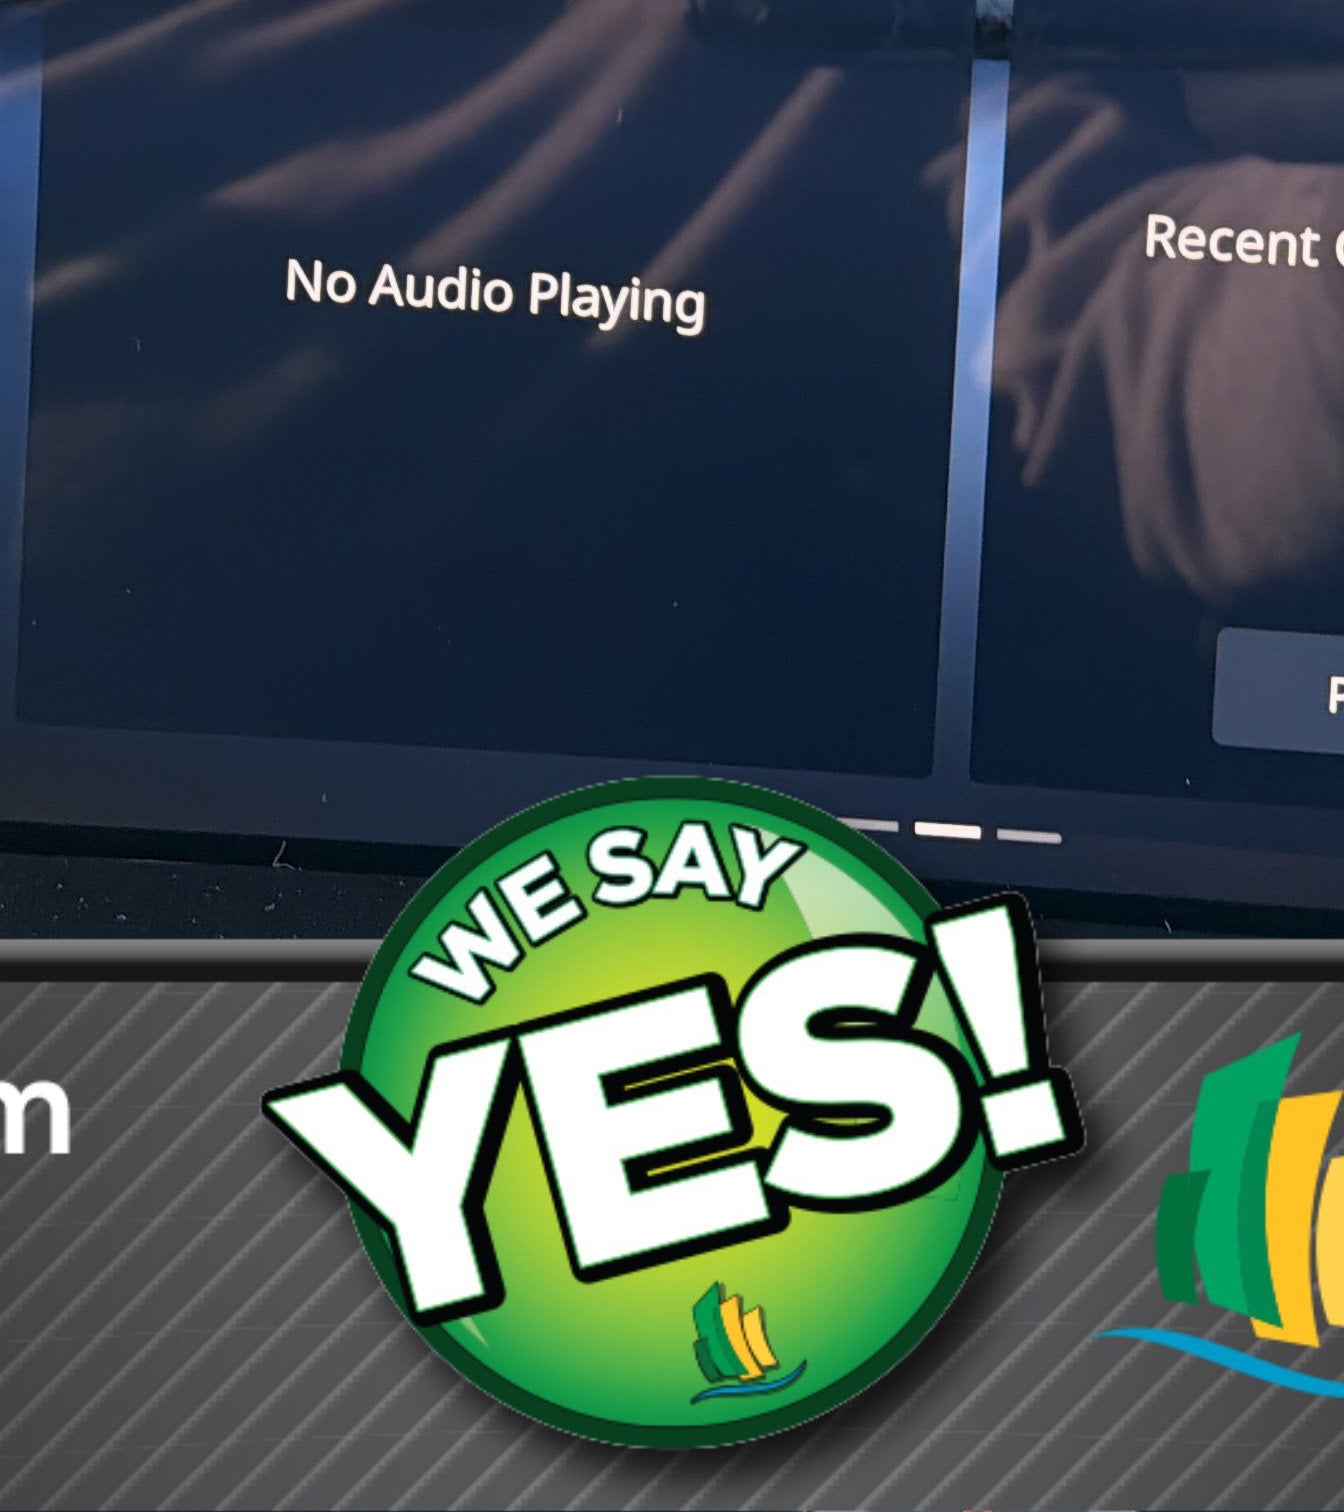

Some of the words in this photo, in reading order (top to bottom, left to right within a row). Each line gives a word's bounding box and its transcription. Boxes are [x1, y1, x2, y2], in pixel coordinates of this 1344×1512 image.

[1145, 213, 1321, 268] Recent
[286, 258, 357, 304] No
[367, 263, 514, 313] Audio
[529, 271, 705, 337] Playing
